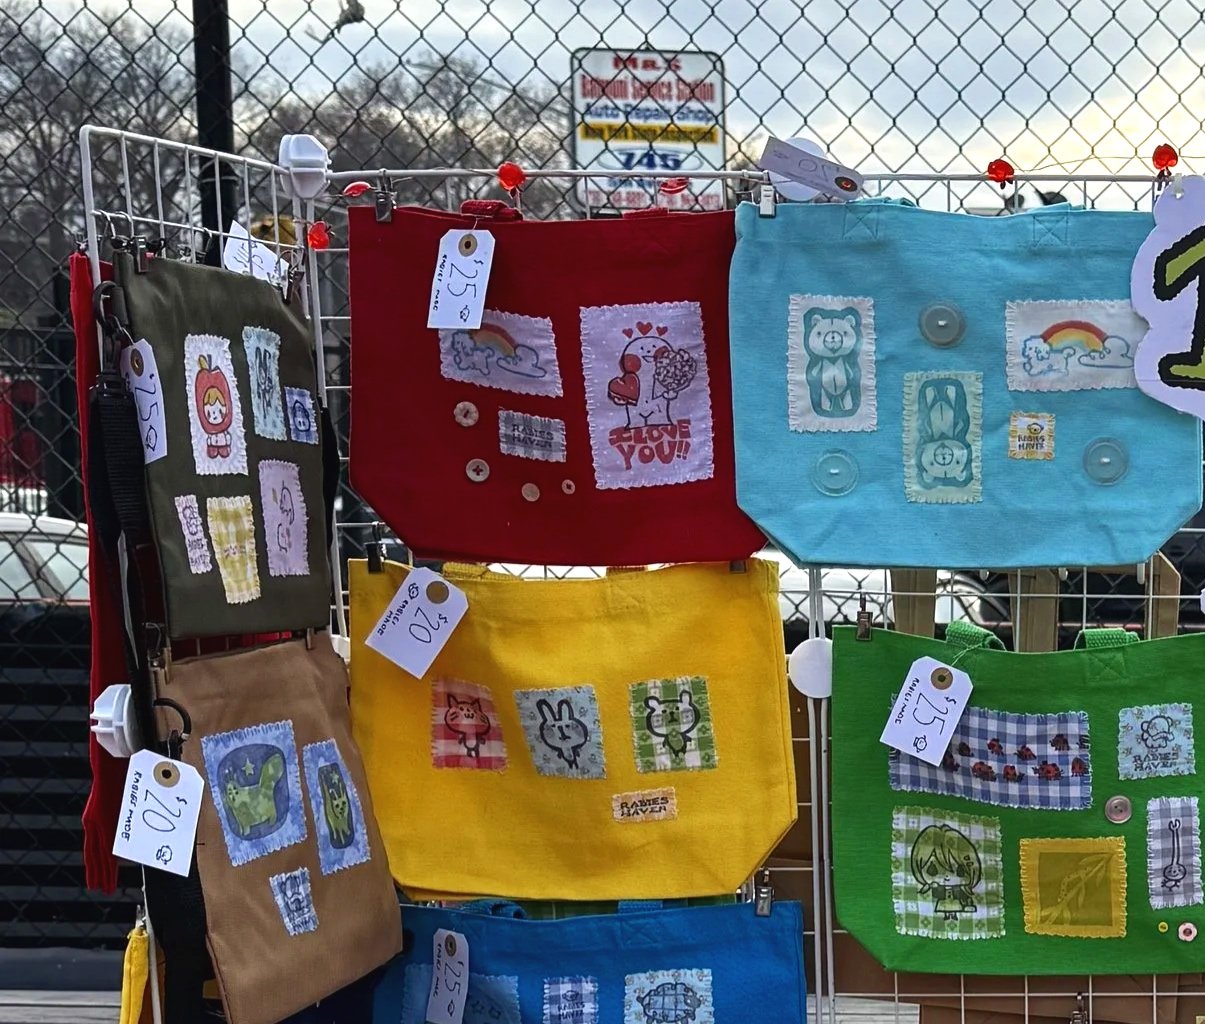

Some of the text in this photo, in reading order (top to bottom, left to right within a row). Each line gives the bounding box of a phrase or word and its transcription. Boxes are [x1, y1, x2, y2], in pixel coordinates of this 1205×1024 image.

[633, 418, 692, 444] LOVE
[616, 439, 692, 471] YOU!!
[142, 788, 188, 833] $20
[620, 796, 670, 810] RABIES
